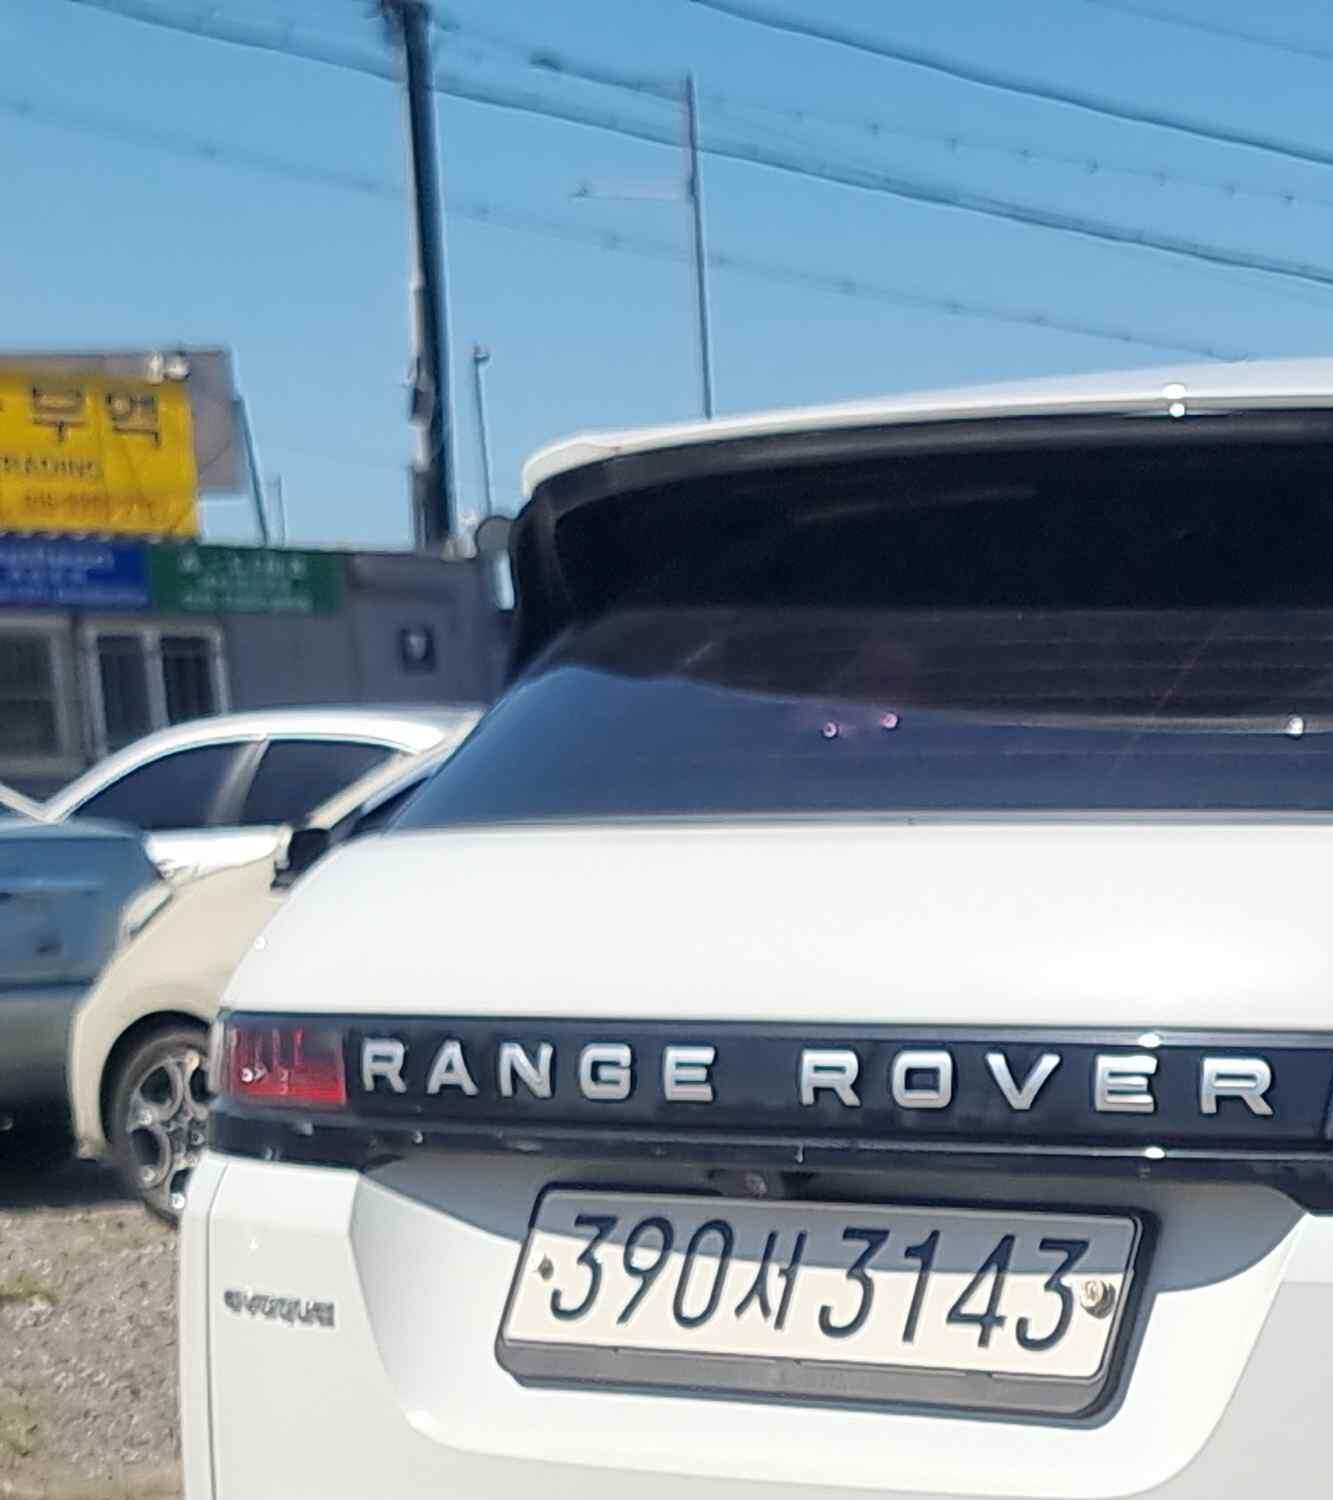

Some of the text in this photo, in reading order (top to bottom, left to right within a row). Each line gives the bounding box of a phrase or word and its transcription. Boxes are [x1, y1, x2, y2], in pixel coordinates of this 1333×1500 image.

[361, 1037, 1274, 1116] RANGE ROVER
[550, 1213, 1090, 1351] 390서3143
